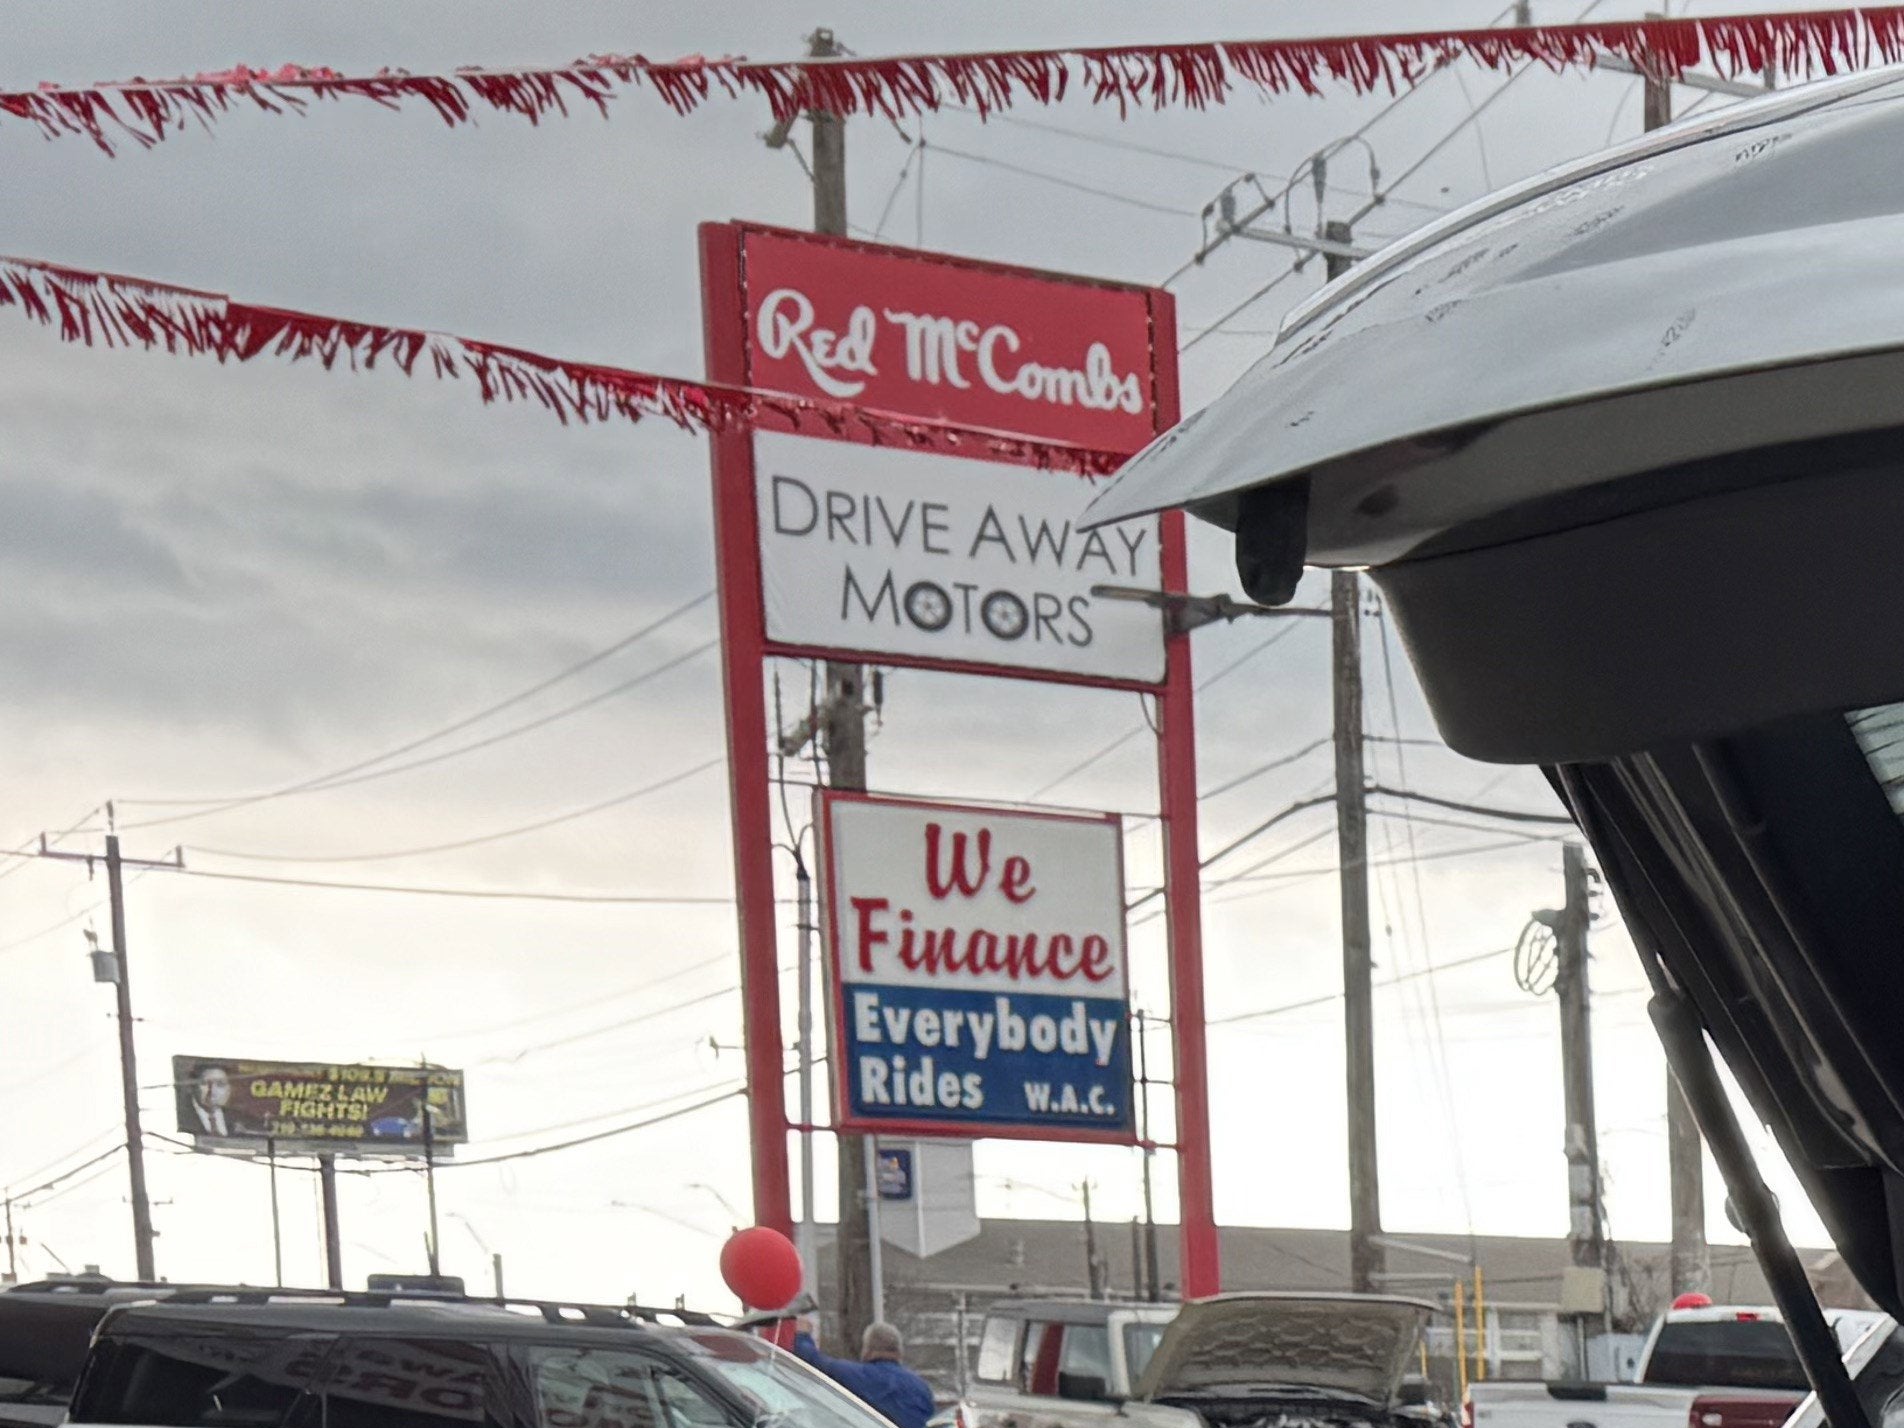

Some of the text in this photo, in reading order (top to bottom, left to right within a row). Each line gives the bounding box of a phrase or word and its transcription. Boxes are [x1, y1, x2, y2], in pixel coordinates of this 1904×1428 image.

[757, 288, 1144, 414] Red McCombs
[772, 475, 1148, 577] DRIVE AWAY
[840, 565, 1094, 649] MOTORS
[923, 822, 1037, 904] We
[850, 896, 1115, 983] Finance
[854, 991, 1118, 1066] Everybody
[337, 1084, 389, 1104] LAW
[859, 1056, 1115, 1116] Rides W.A.C.
